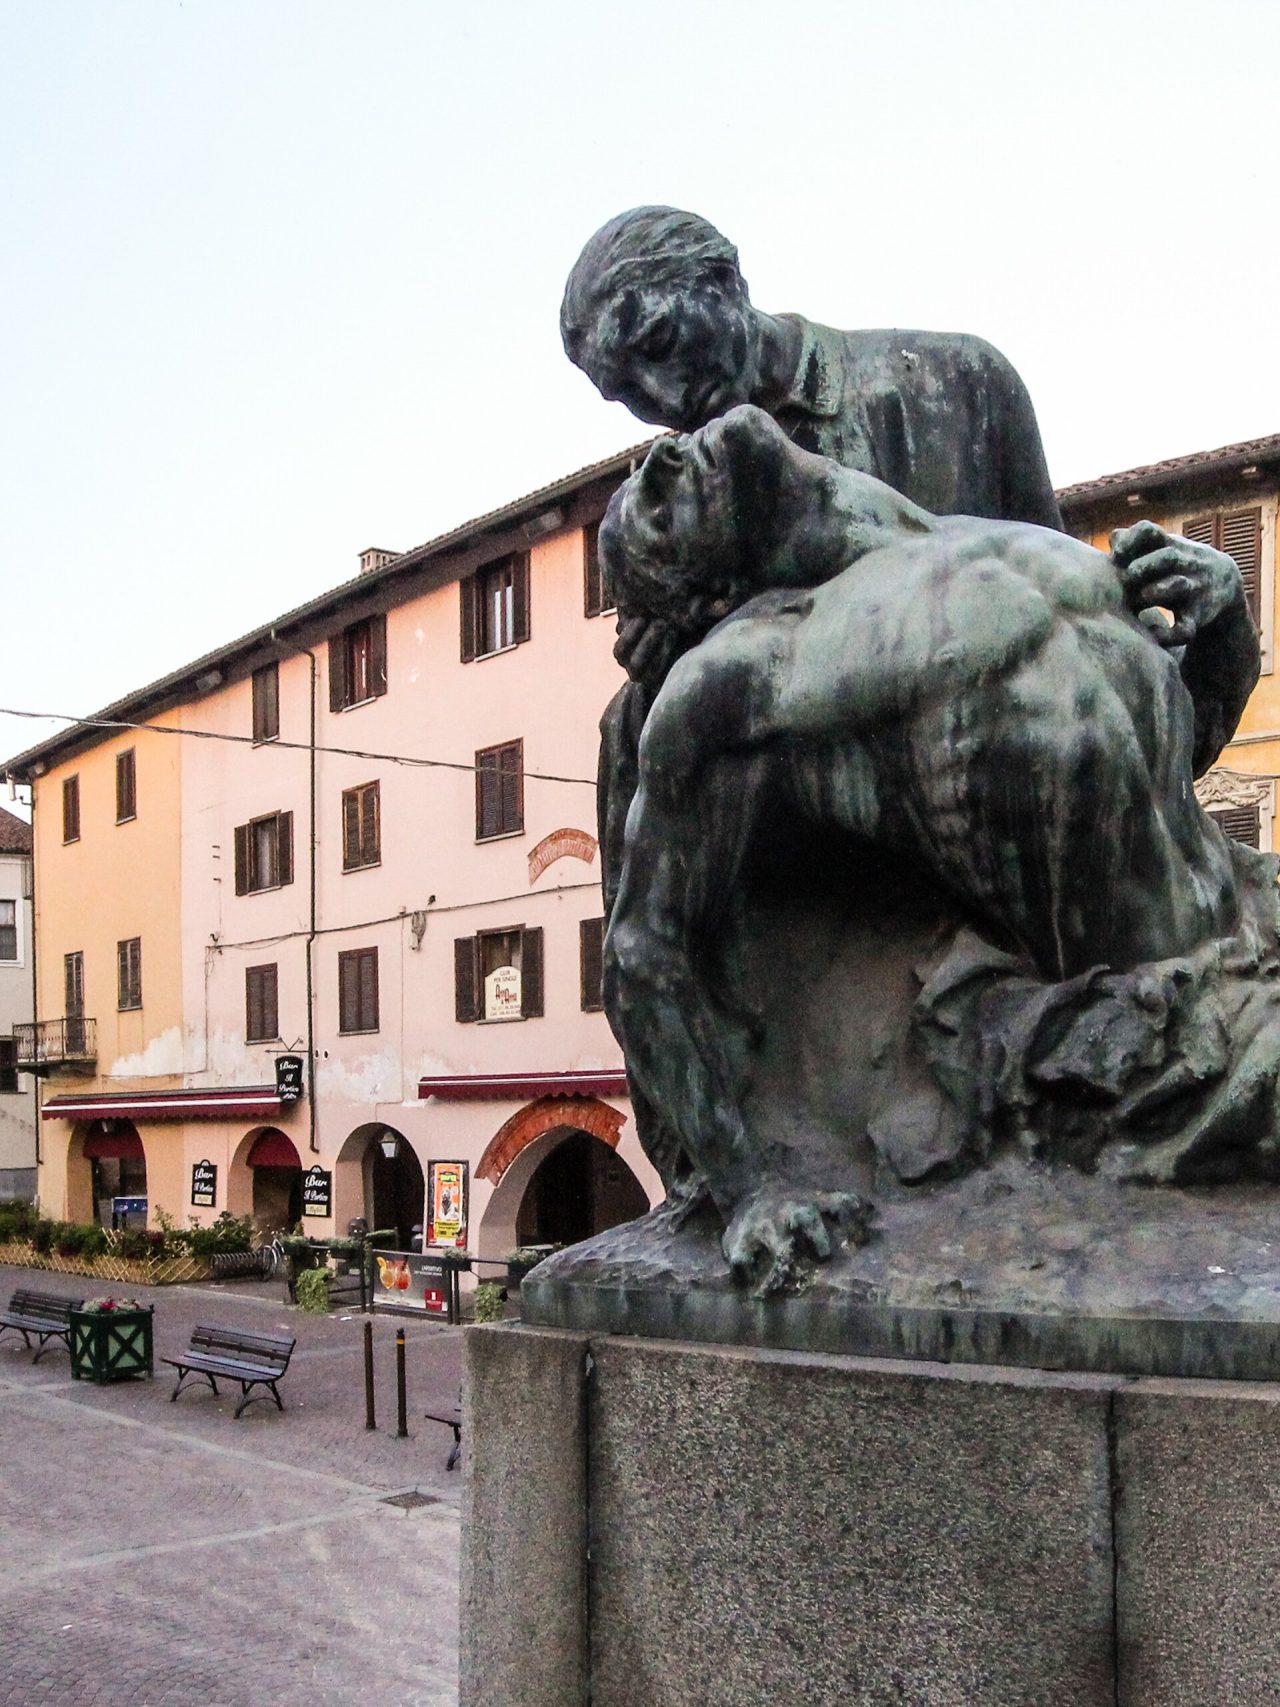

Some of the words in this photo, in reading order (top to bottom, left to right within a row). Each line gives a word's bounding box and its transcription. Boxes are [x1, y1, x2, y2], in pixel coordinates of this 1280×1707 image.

[279, 1061, 299, 1070] Bar
[194, 1167, 214, 1180] Bar
[304, 1174, 328, 1188] Bar
